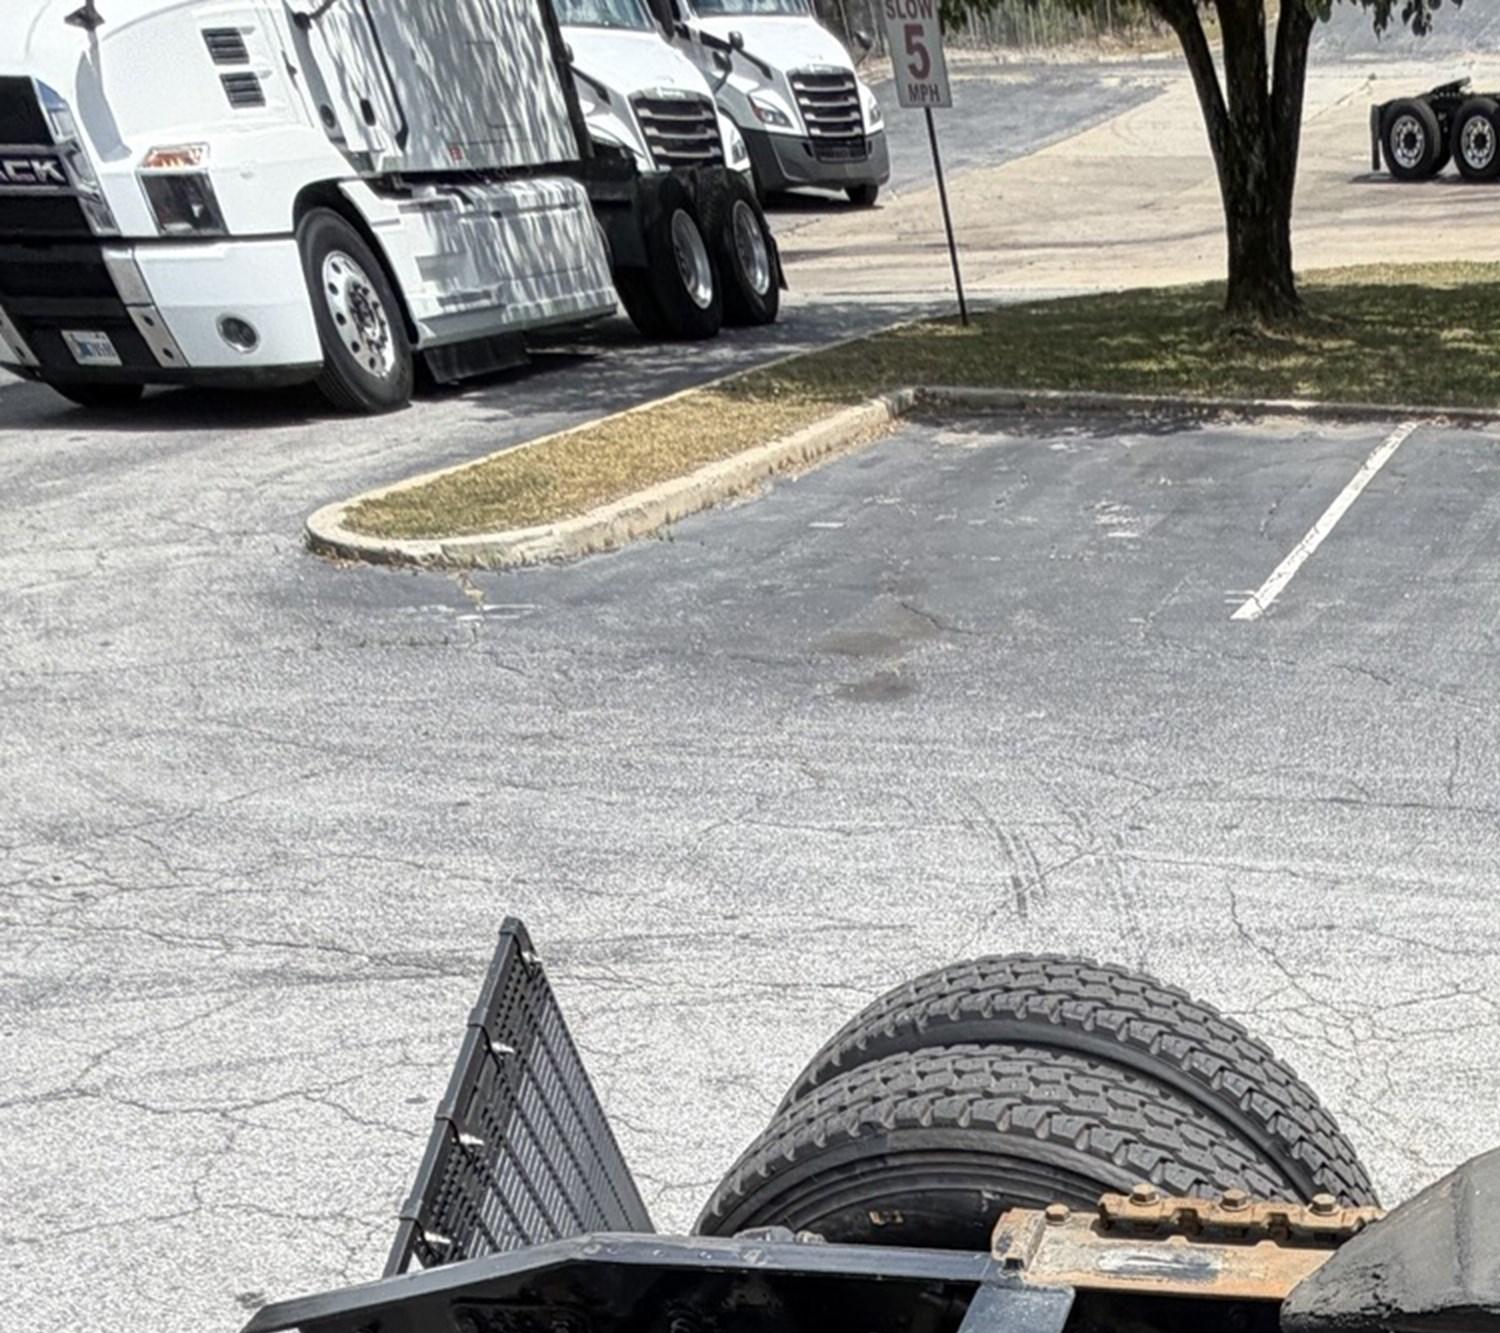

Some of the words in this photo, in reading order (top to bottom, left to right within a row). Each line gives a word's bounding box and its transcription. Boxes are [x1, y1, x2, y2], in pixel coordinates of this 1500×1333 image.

[885, 0, 933, 19] SLOW
[904, 24, 930, 80] 5
[907, 83, 940, 101] MPH
